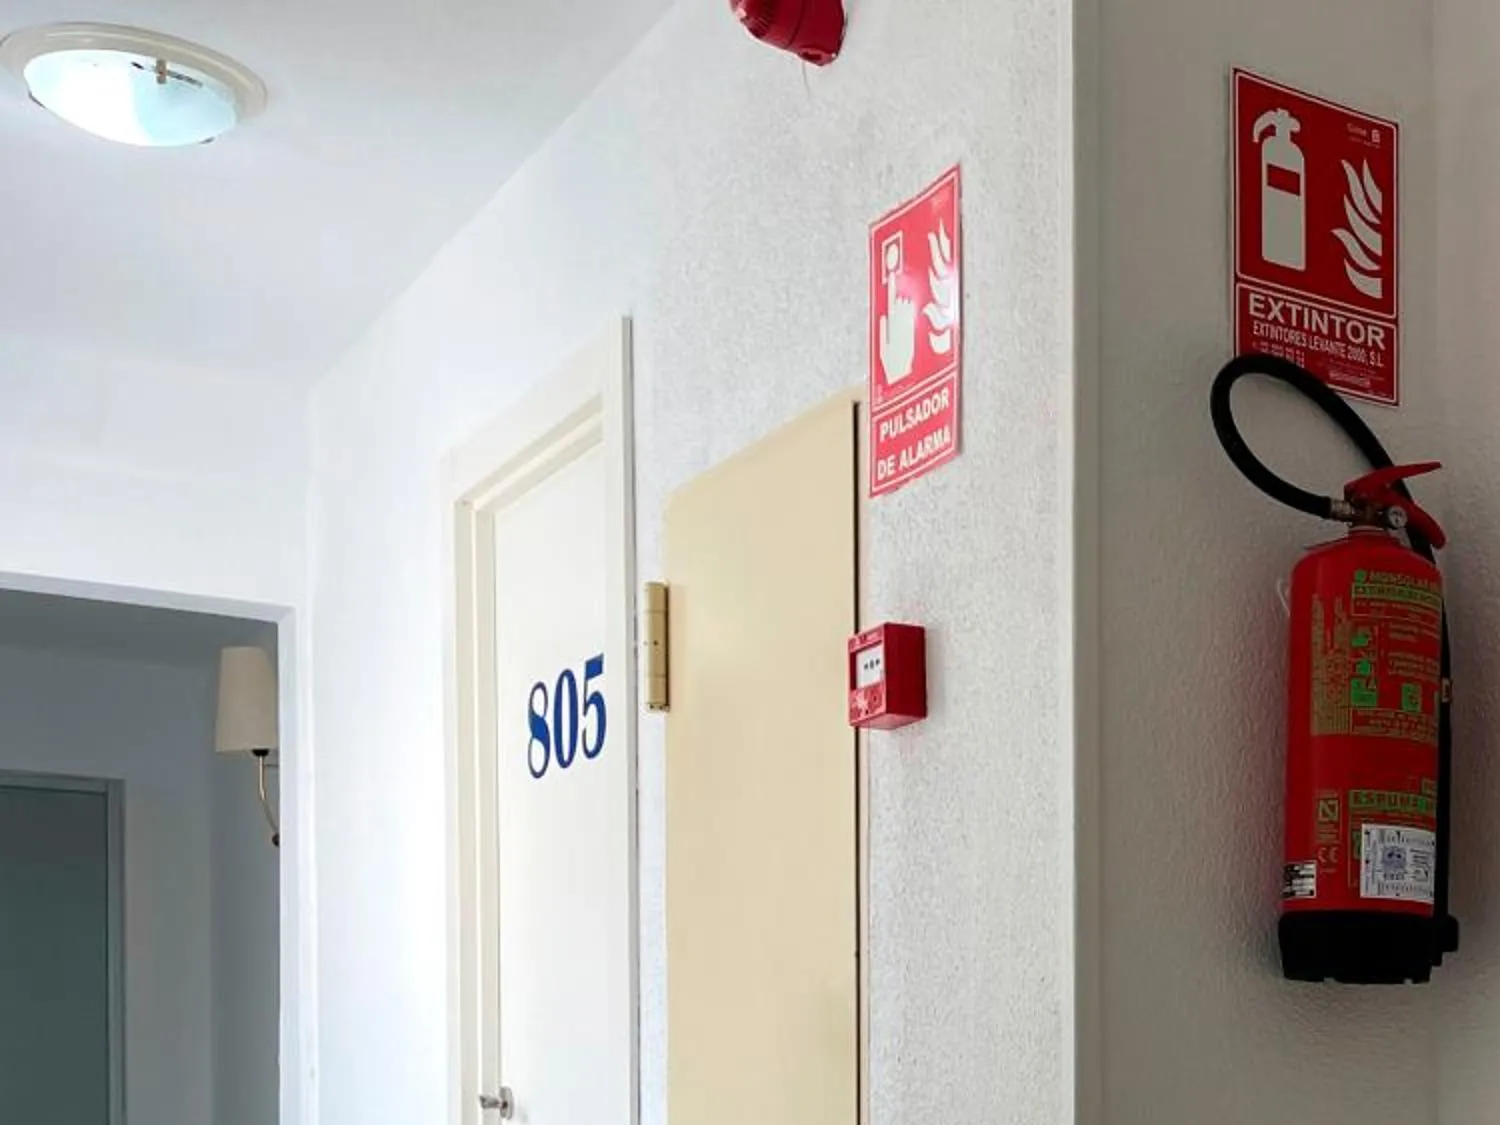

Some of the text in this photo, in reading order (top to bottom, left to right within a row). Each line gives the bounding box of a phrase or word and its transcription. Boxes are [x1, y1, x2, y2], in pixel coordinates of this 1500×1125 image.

[1249, 293, 1385, 350] EXTINTOR
[1253, 320, 1307, 348] EXTINTORES
[880, 387, 949, 442] PULSADOR
[877, 424, 951, 480] DE ALARMA
[527, 653, 607, 779] 805
